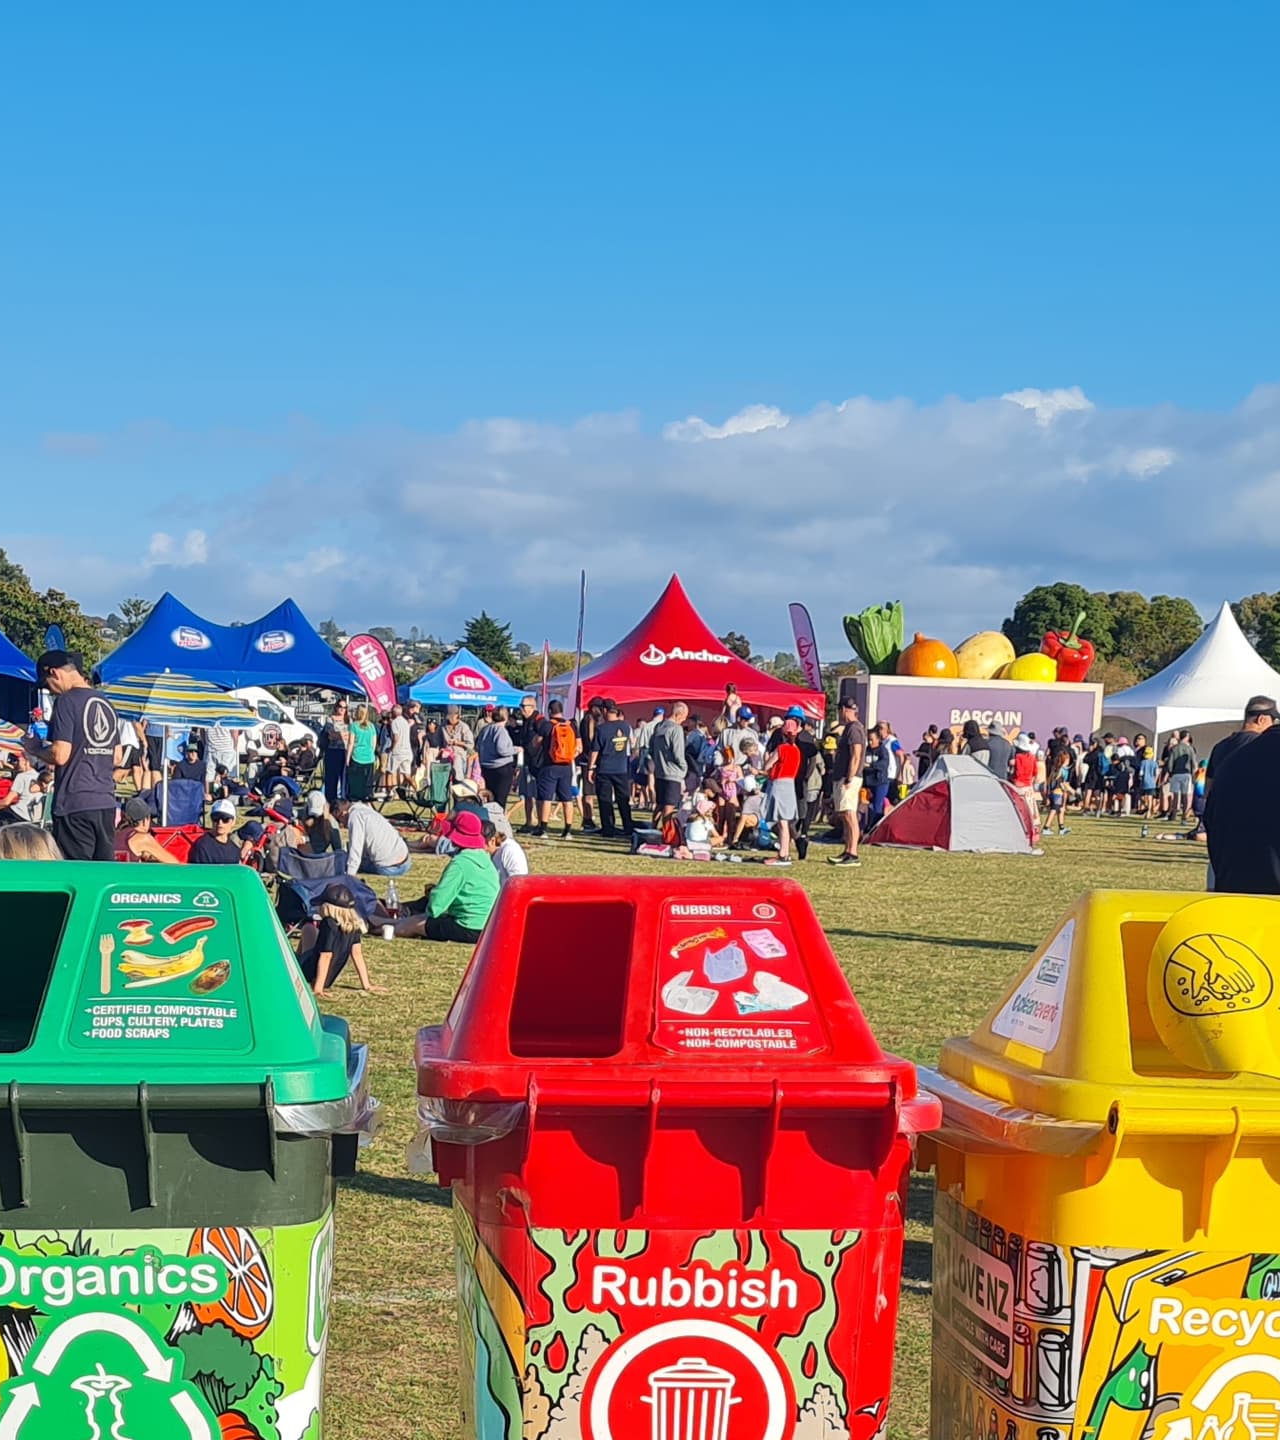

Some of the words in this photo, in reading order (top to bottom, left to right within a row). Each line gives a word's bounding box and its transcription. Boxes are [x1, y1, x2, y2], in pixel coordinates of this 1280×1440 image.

[668, 647, 732, 664] Anchor
[950, 709, 1022, 726] BARGAIN
[111, 893, 181, 904] ORGANICS
[671, 904, 732, 916] RUBBISH
[92, 1004, 151, 1016] CERTIFIED
[154, 1005, 238, 1018] COMPOSTABLE
[92, 1016, 125, 1027] CUPS,
[128, 1016, 178, 1028] CULTERY,
[180, 1017, 224, 1028] PLATES
[91, 1028, 122, 1038] FOOD
[125, 1028, 170, 1039] SCRAPS
[685, 1028, 793, 1038] NON-RECYCLABLES
[686, 1038, 797, 1049] NON-COMPOSTABLE
[592, 1265, 798, 1308] Rubbish
[952, 1254, 985, 1308] LOVE
[987, 1271, 1009, 1322] NZ
[989, 1335, 1007, 1358] CARE
